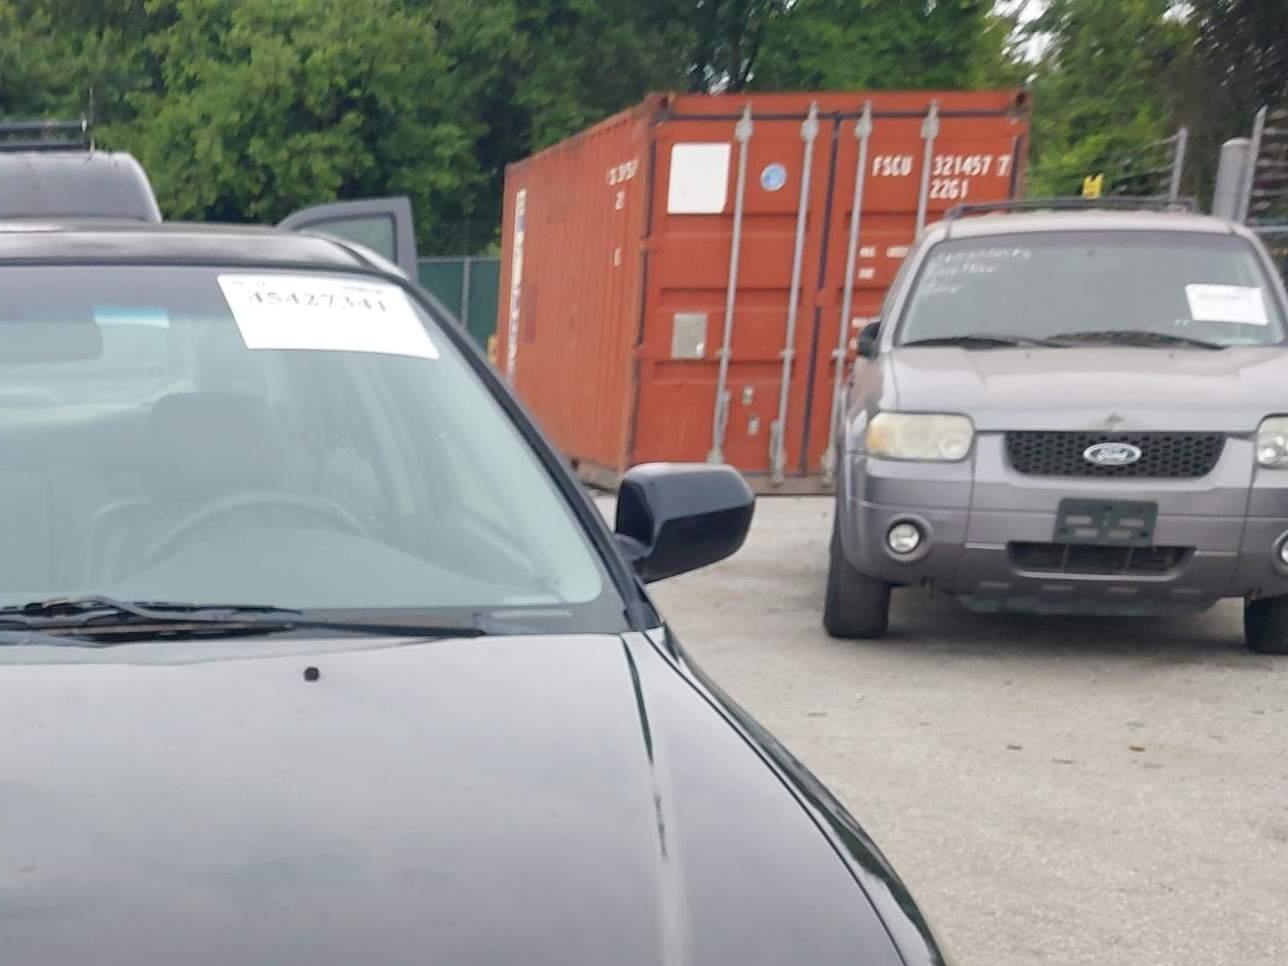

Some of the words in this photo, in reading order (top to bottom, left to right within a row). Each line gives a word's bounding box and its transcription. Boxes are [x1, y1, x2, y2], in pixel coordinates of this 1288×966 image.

[932, 154, 992, 176] 321457
[997, 154, 1012, 176] 7
[248, 291, 387, 312] 45427341
